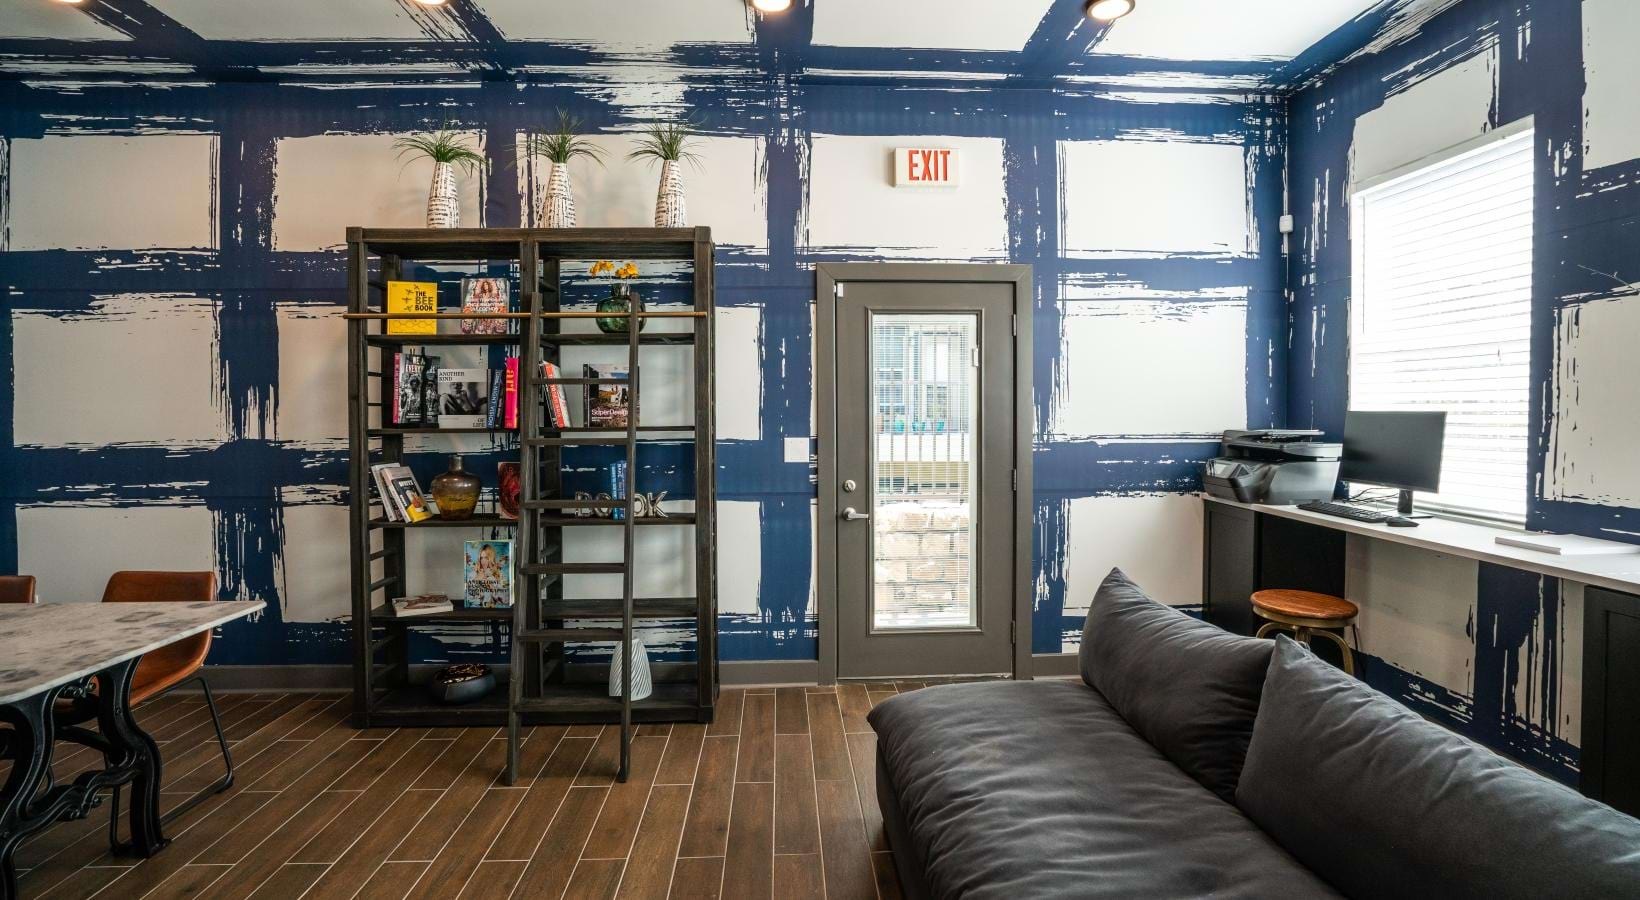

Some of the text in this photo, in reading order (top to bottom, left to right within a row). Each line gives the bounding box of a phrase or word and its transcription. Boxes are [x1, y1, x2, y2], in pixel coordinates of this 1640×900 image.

[908, 150, 950, 181] EXIT
[415, 297, 434, 305] BEE
[506, 369, 517, 392] art
